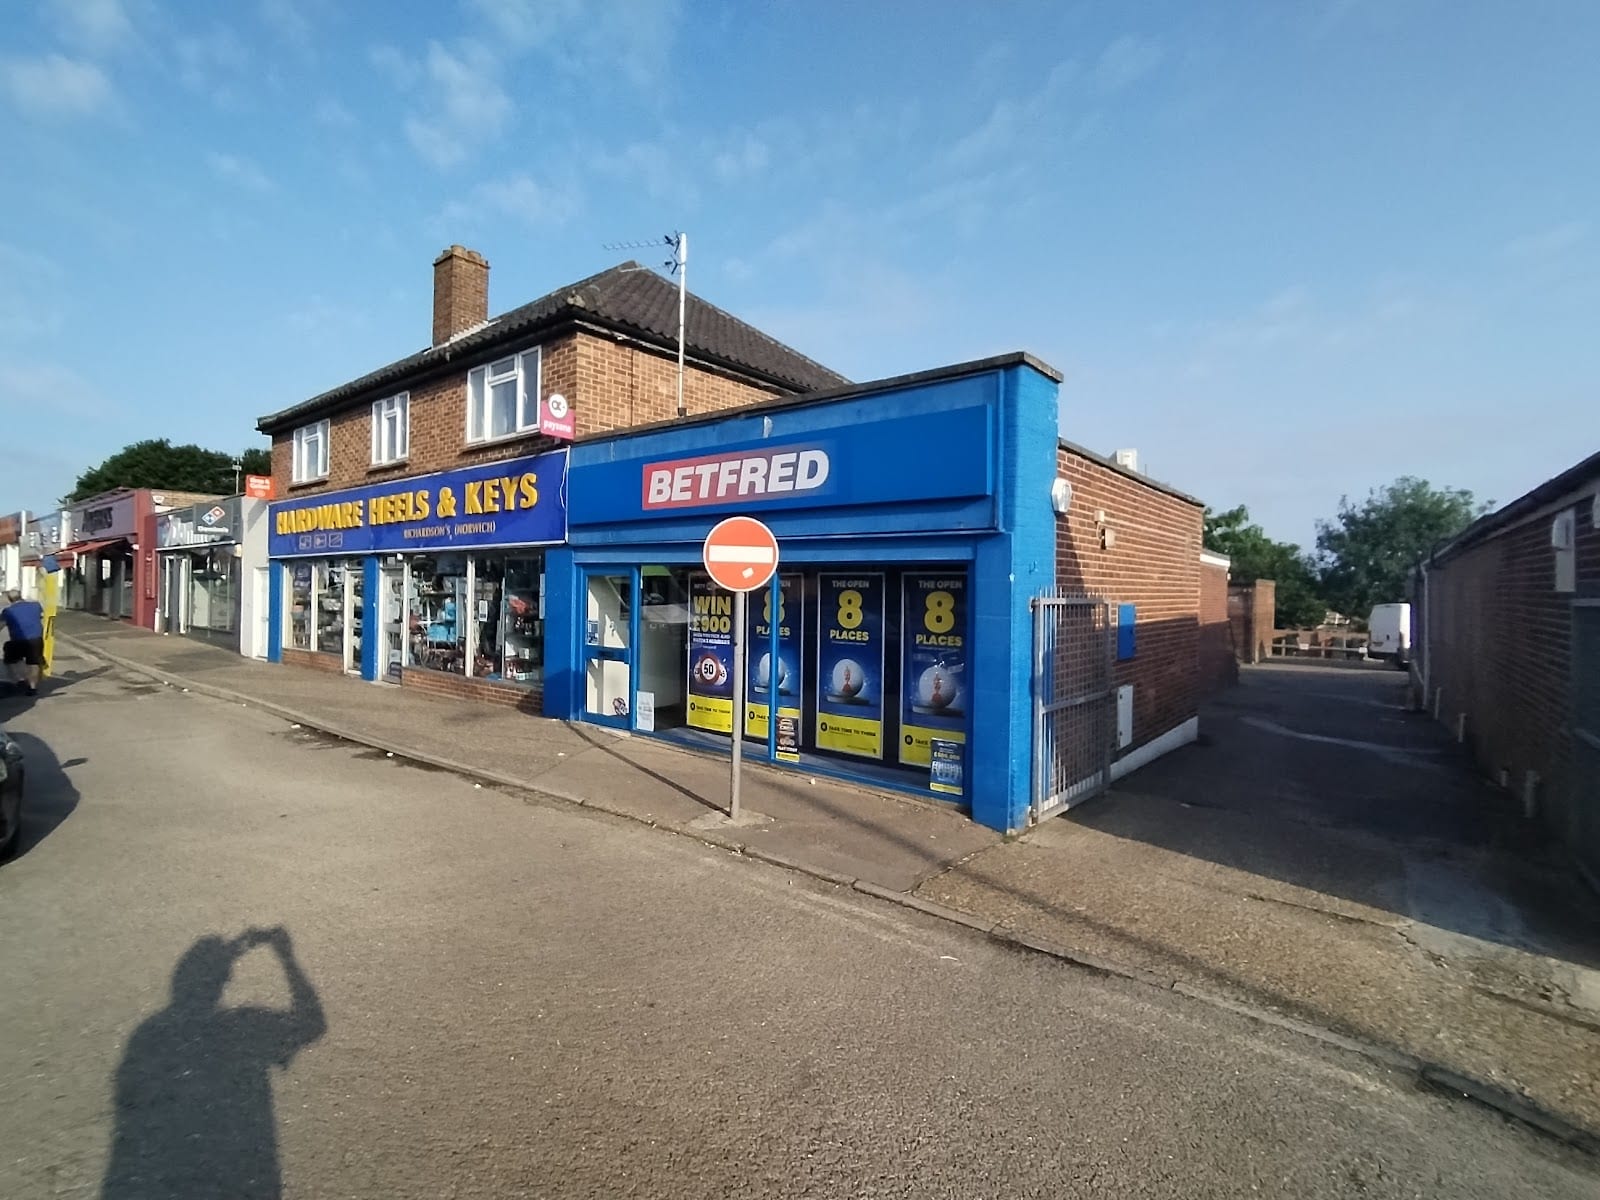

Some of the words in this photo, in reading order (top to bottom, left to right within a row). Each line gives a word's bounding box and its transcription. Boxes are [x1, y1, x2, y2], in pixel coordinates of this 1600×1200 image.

[648, 450, 830, 503] BETFRED
[276, 500, 363, 535] HARDWARE
[368, 490, 430, 525] HEELS
[437, 486, 456, 518] &
[464, 472, 538, 514] KEYS
[832, 580, 846, 588] THE
[847, 580, 869, 588] OPEN
[918, 580, 935, 588] THE
[936, 580, 962, 589] OPEN
[693, 596, 731, 615] WIN
[837, 589, 863, 629] 8
[924, 591, 955, 634] 8
[693, 616, 731, 633] £900
[756, 626, 791, 636] PLAES
[830, 629, 869, 641] PLACES
[915, 634, 962, 646] PLACES
[703, 663, 714, 675] 50
